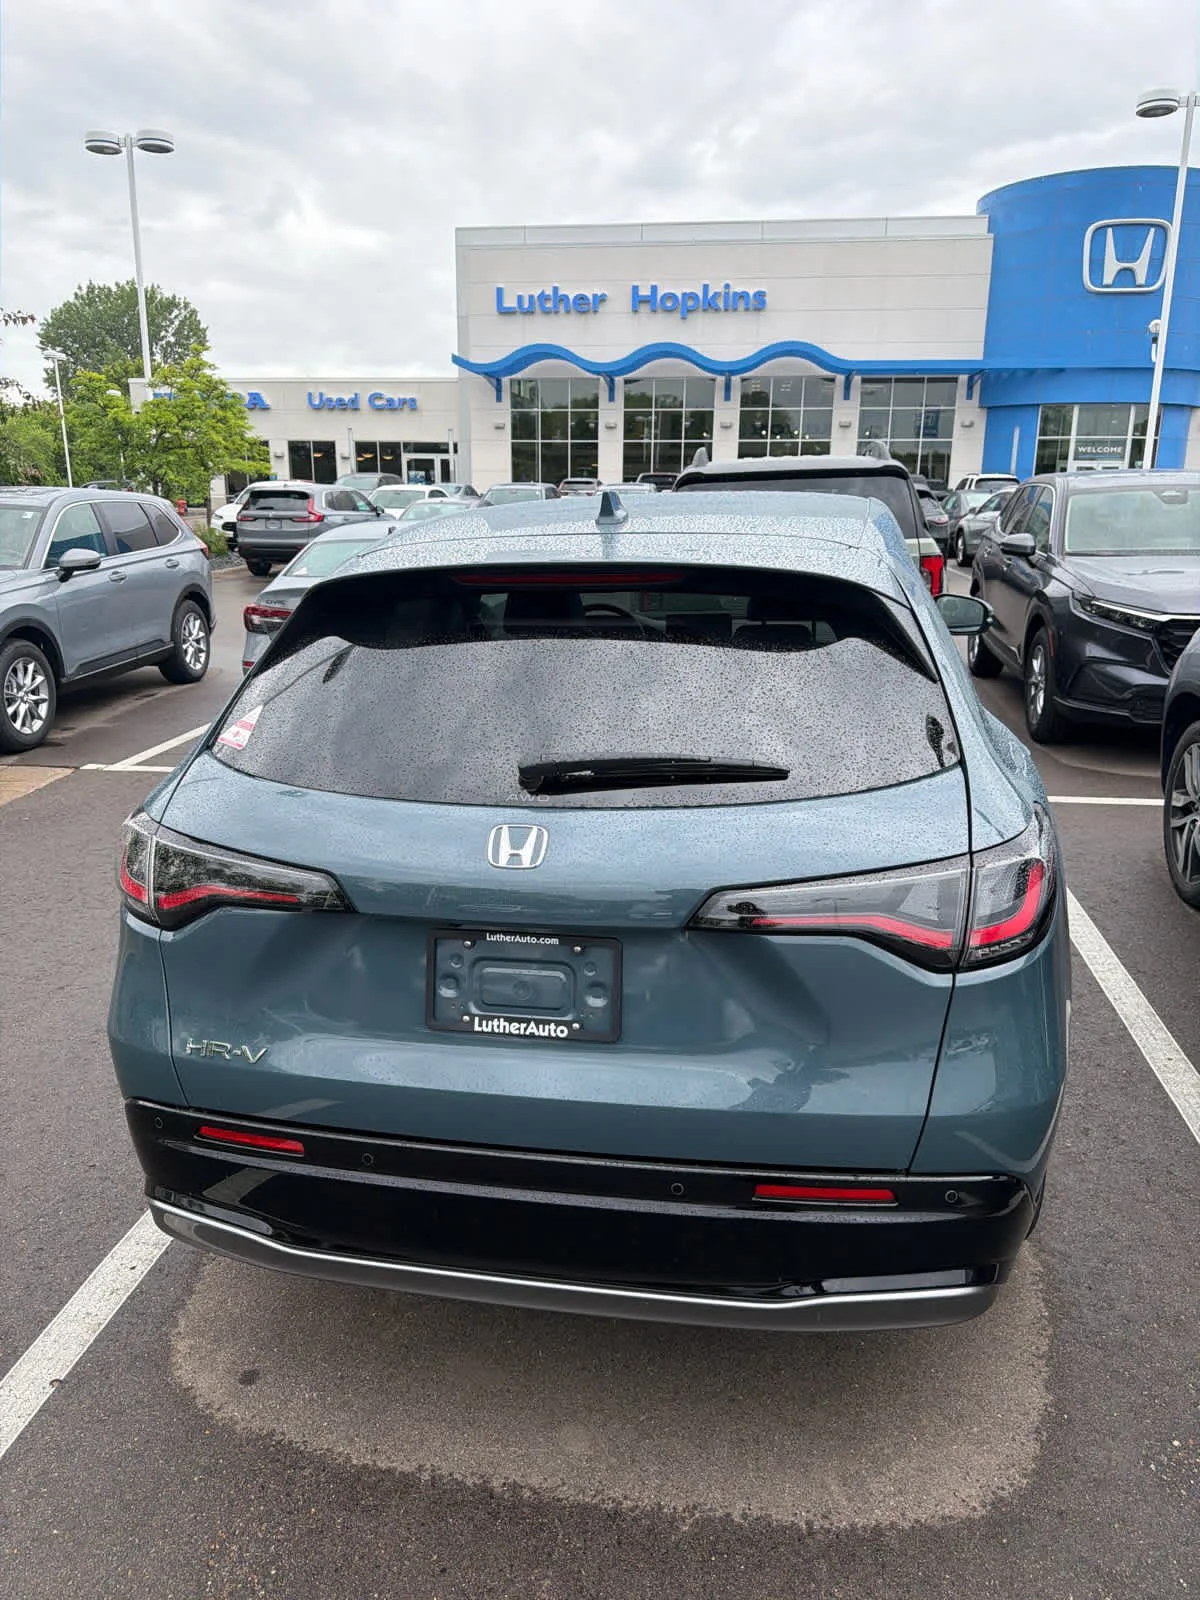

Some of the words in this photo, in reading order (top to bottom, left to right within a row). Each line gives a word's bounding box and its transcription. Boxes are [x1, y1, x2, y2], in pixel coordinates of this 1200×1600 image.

[495, 285, 607, 314] Luther
[631, 282, 768, 320] Hopkins
[307, 391, 360, 411] Used
[367, 391, 418, 411] Cars
[1077, 446, 1123, 454] WELCOME
[505, 792, 550, 802] AWD
[486, 932, 559, 945] LutherAuto.com
[473, 1015, 569, 1039] LutherAuto
[185, 1038, 268, 1064] HR-V
